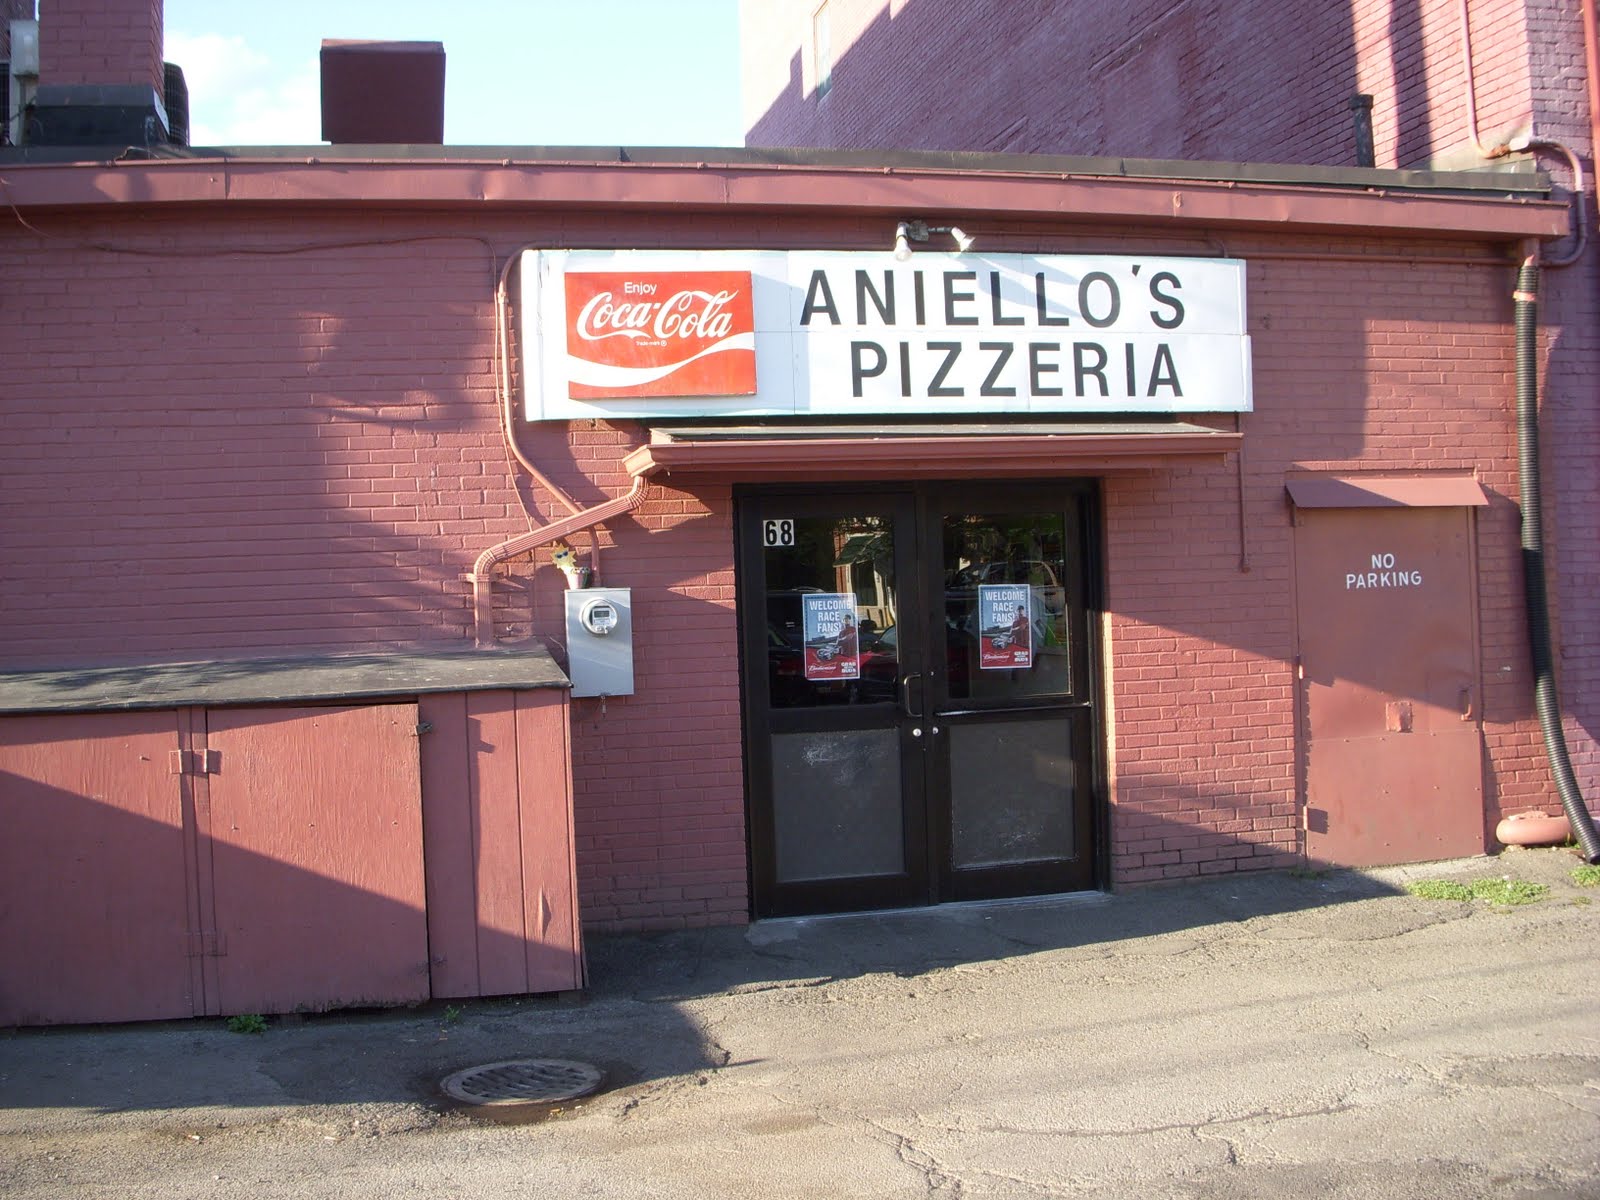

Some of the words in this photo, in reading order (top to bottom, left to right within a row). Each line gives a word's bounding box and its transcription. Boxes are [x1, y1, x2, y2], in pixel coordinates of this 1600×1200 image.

[624, 282, 657, 295] Enjoy
[800, 265, 1185, 329] ANIELLO'S
[577, 290, 739, 340] Coca-Cola
[851, 341, 1184, 398] PIZZERIA
[765, 520, 793, 545] 68
[1371, 553, 1395, 569] NO
[1346, 571, 1422, 589] PARKING
[984, 591, 1025, 601] WELCOME
[809, 600, 852, 611] WELCOME
[992, 602, 1014, 612] RACE
[817, 611, 840, 622] RACE
